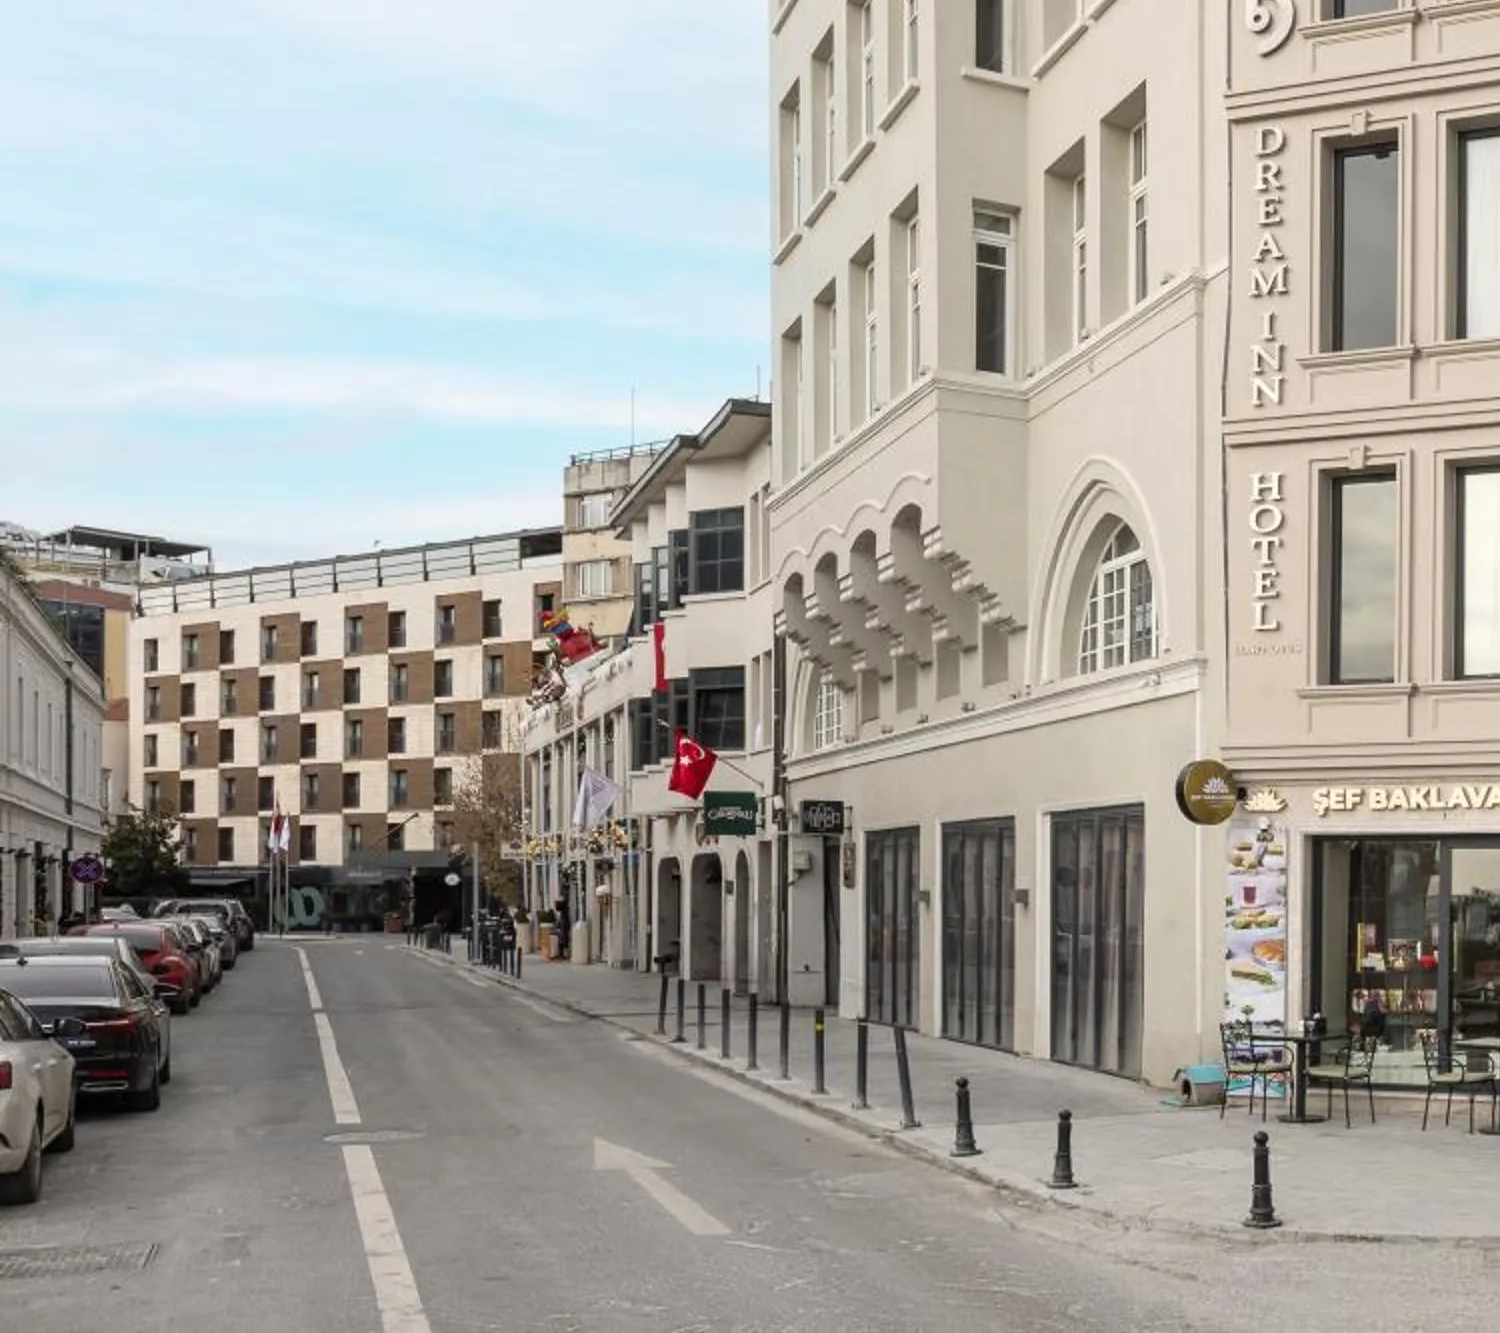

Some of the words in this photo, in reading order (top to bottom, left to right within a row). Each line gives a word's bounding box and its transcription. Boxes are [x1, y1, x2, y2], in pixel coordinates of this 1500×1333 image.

[1248, 125, 1289, 297] DREAM
[1250, 310, 1286, 408] INN
[1248, 471, 1285, 632] HOTEL
[1312, 786, 1365, 817] ŞEF
